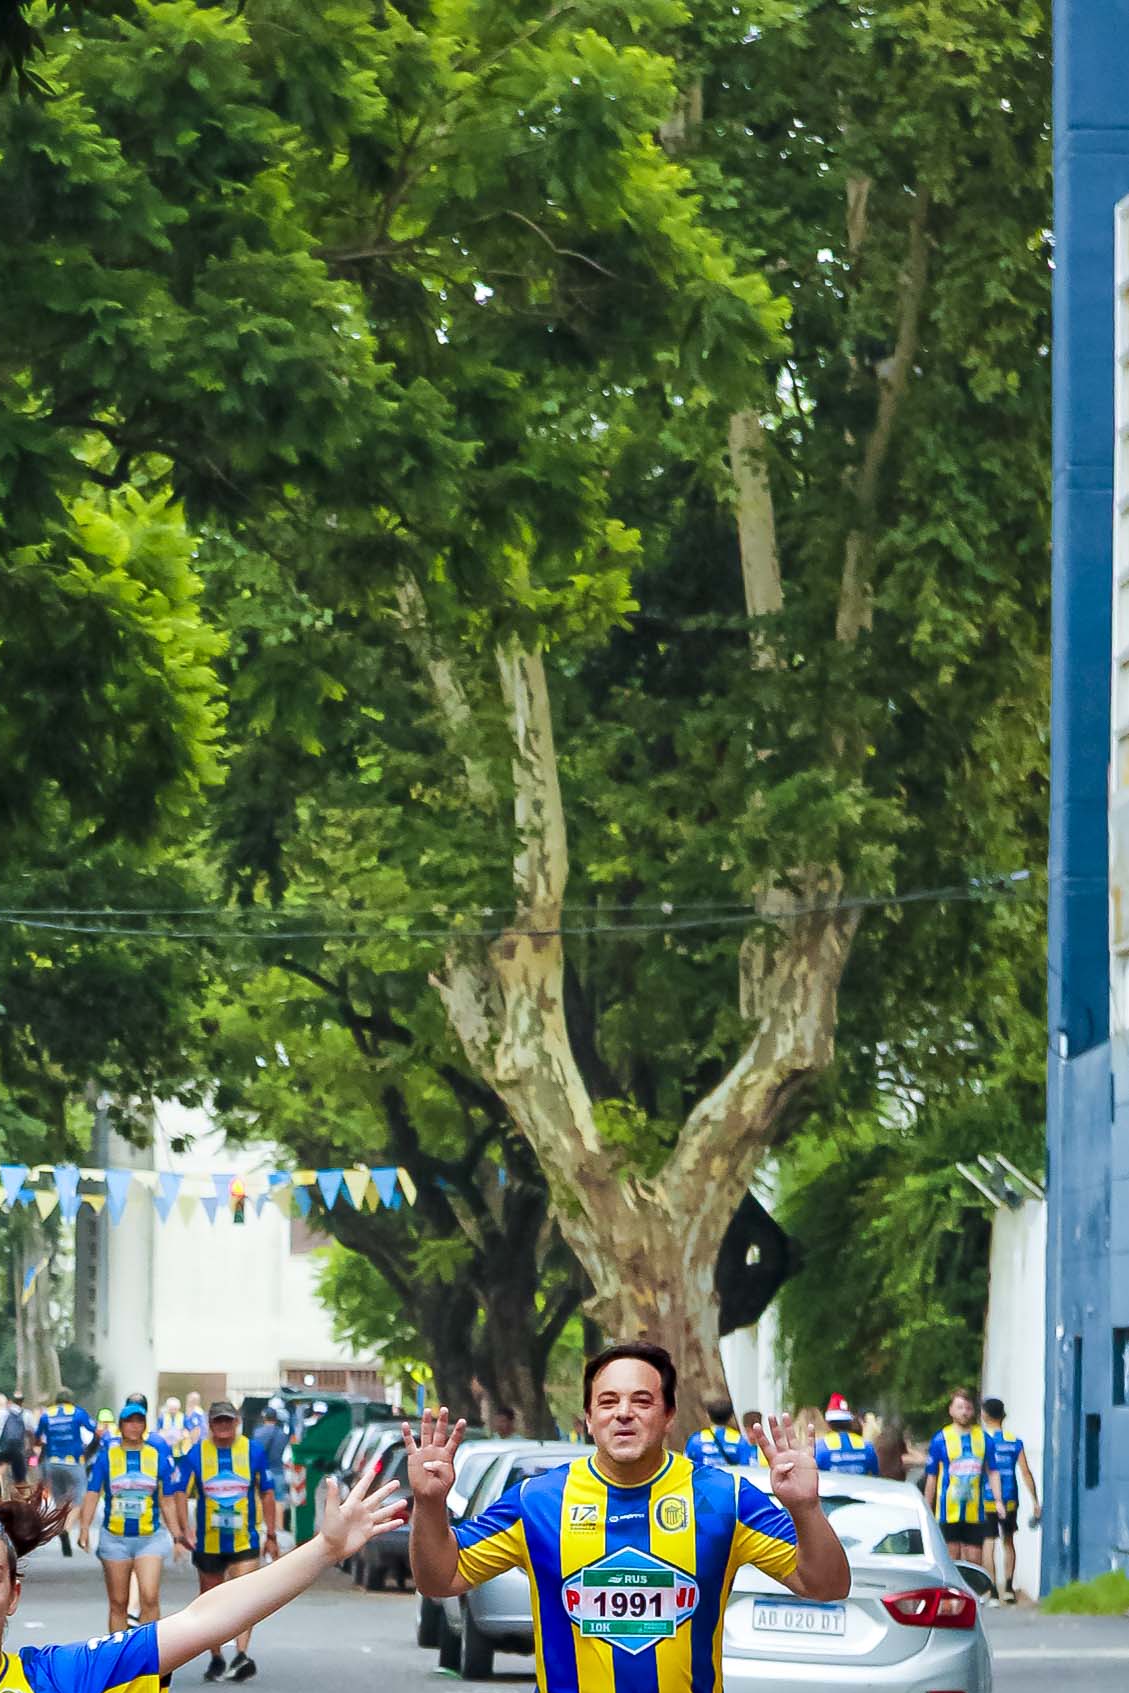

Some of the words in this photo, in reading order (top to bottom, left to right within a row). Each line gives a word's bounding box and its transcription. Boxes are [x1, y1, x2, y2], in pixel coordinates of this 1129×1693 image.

[624, 1574, 648, 1584] RUS
[593, 1591, 662, 1618] 1991
[589, 1622, 611, 1633] 10K
